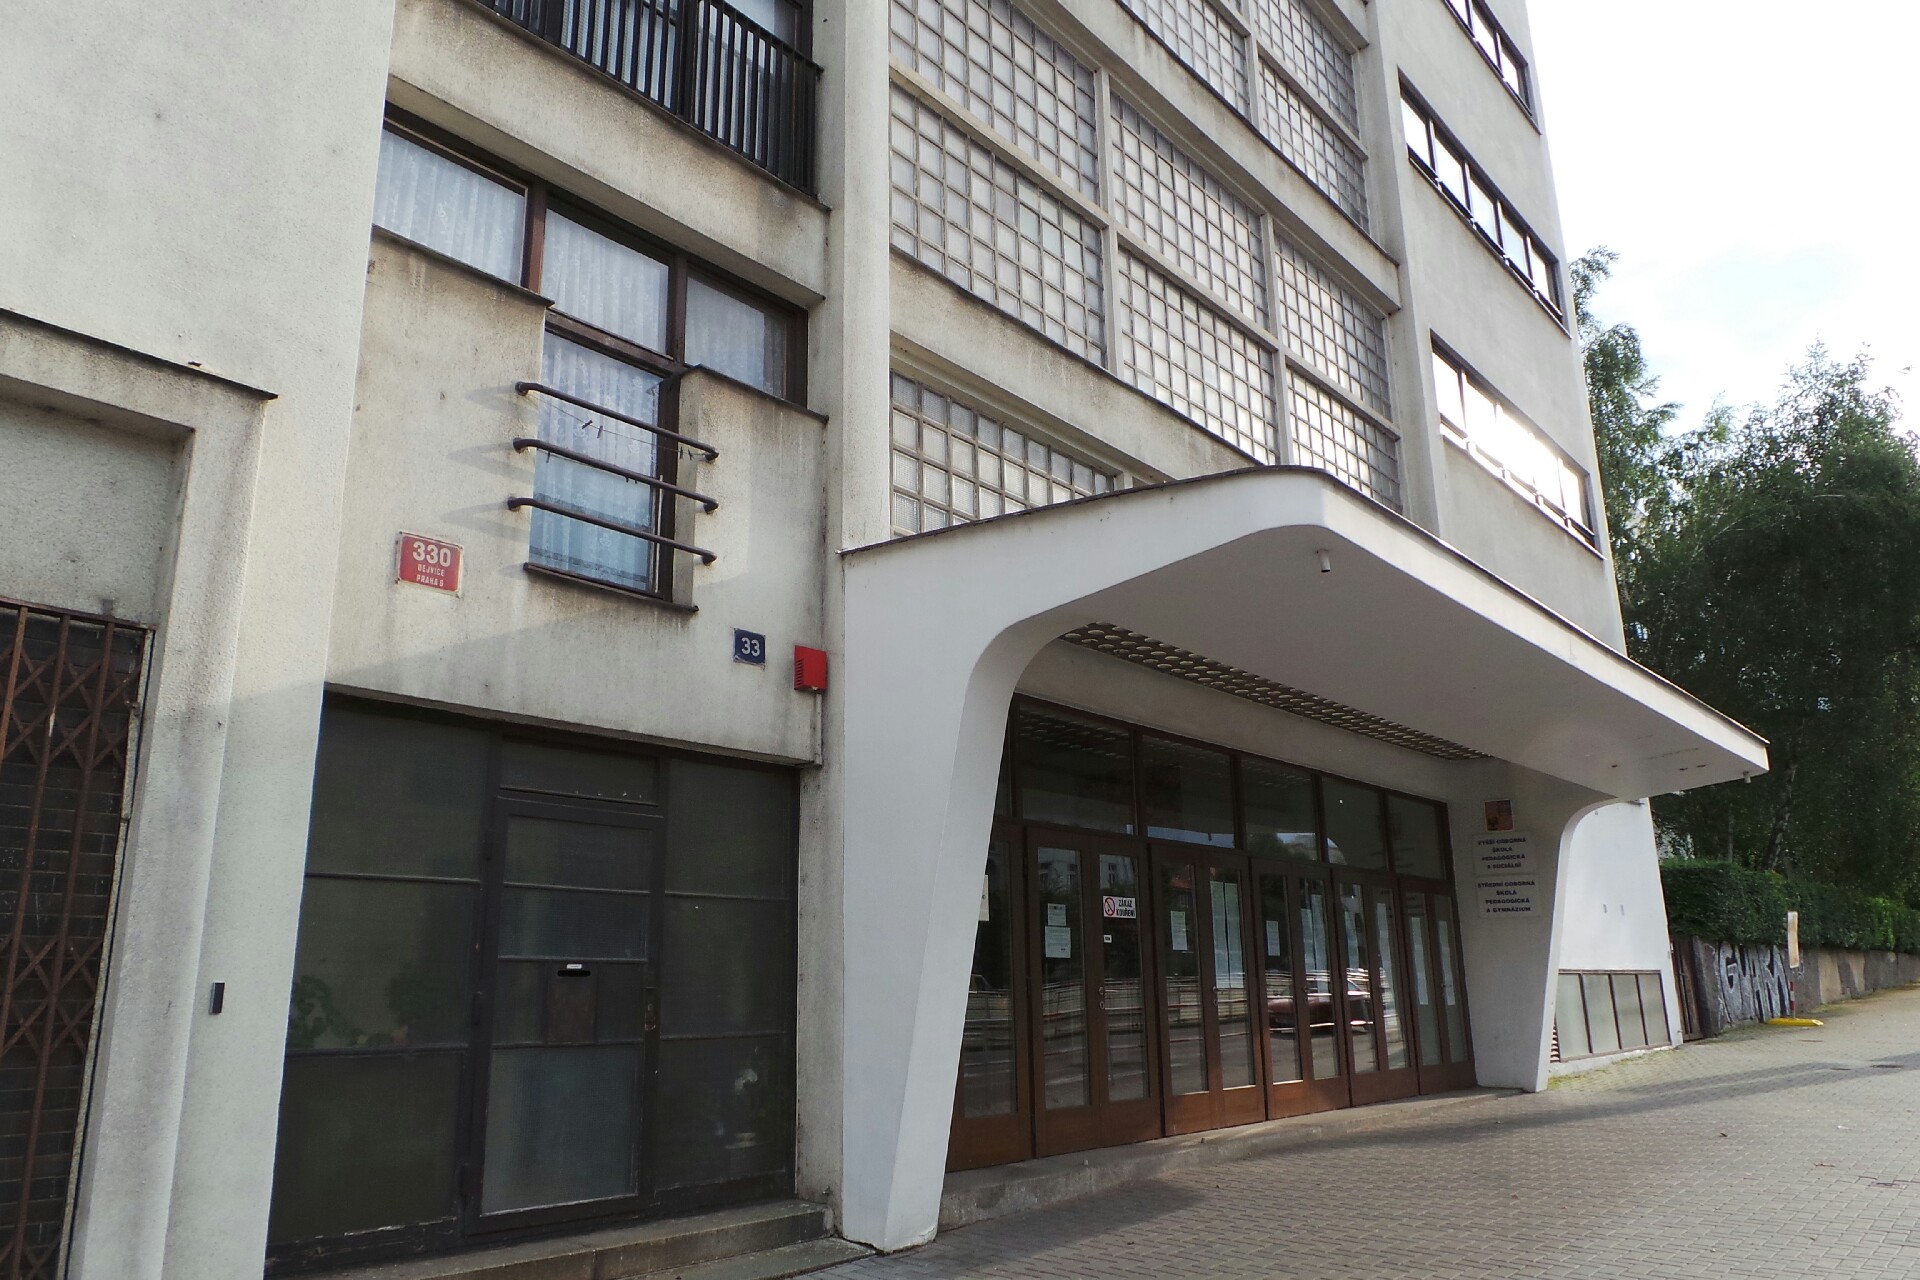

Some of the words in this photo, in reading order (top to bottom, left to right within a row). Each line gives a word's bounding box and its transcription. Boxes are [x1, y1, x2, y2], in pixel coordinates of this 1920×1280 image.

[412, 541, 451, 567] 330
[417, 563, 445, 577] DEJVICE
[416, 574, 438, 586] PRAHA
[741, 637, 760, 657] 33
